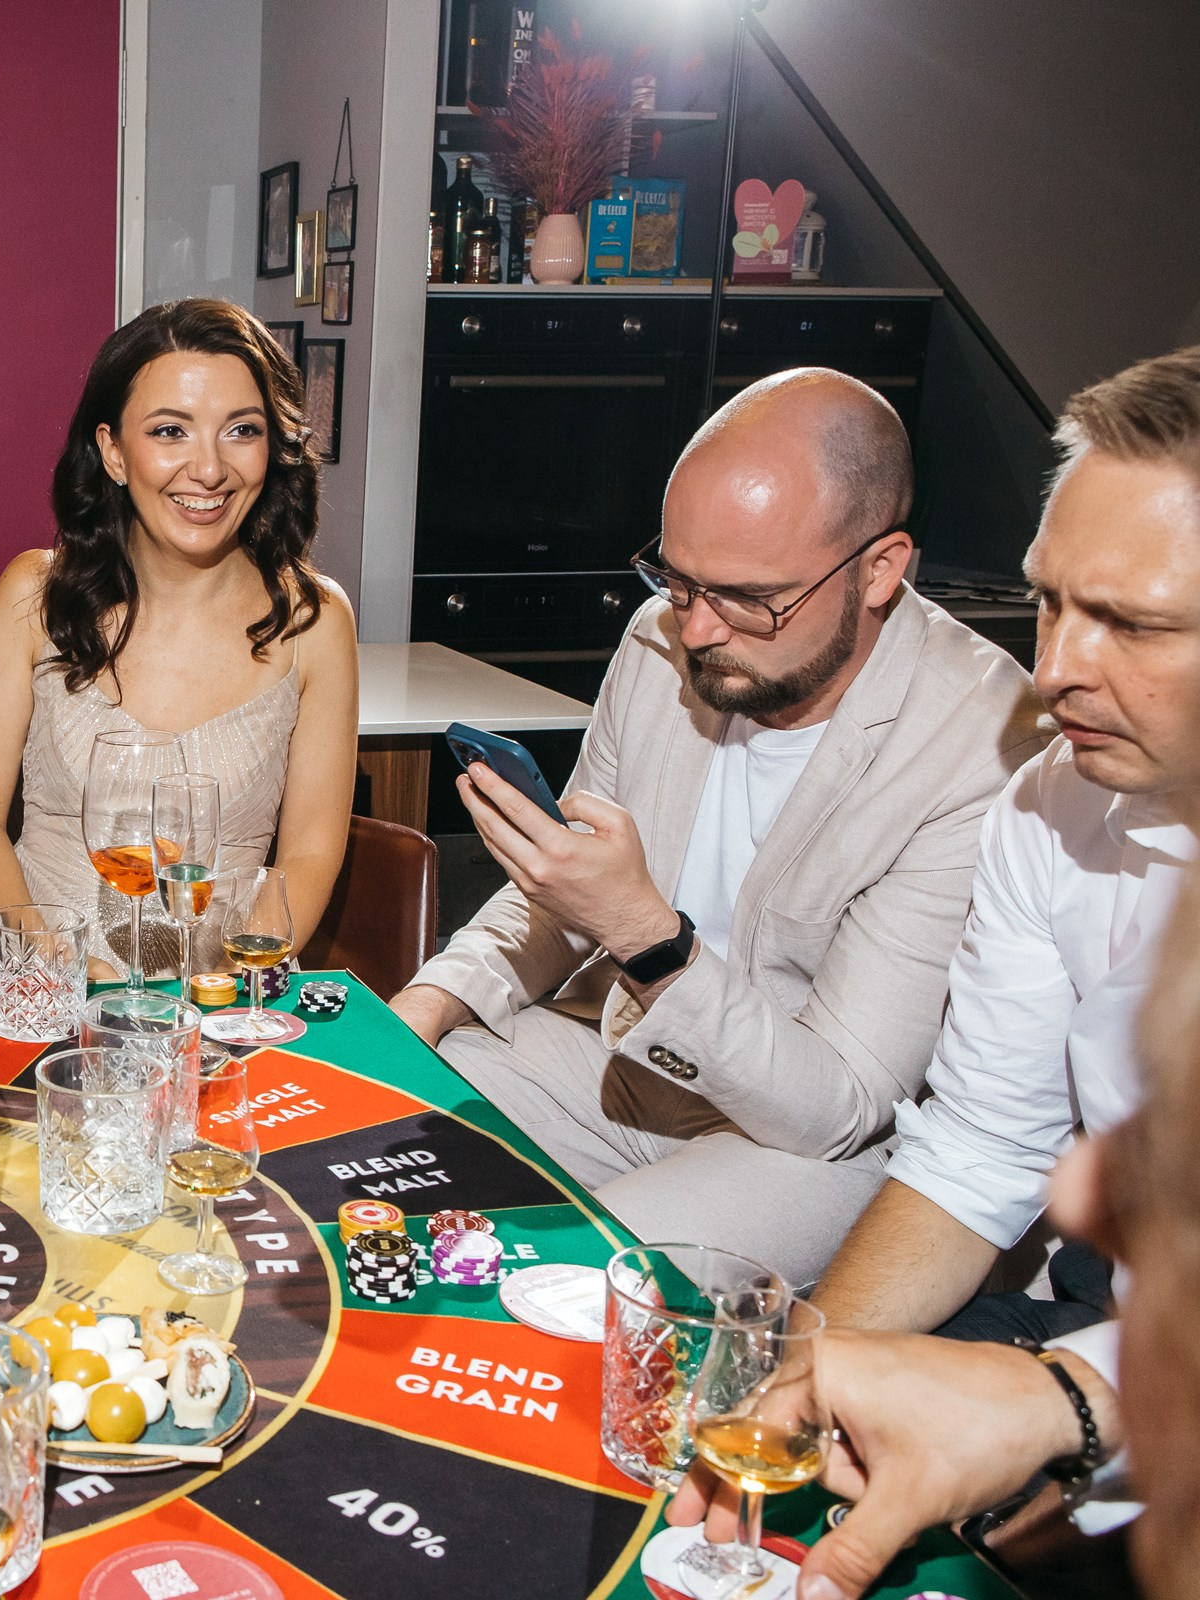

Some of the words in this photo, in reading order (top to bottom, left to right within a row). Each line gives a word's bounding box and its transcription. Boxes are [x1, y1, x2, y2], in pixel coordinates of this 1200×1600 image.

[254, 1099, 327, 1128] MALT
[327, 1149, 437, 1181] BLEND
[361, 1169, 452, 1197] MALT
[215, 1188, 300, 1275] TYPE
[409, 1346, 564, 1393] BLEND
[395, 1374, 559, 1423] GRAIN
[326, 1488, 449, 1559] 40%
